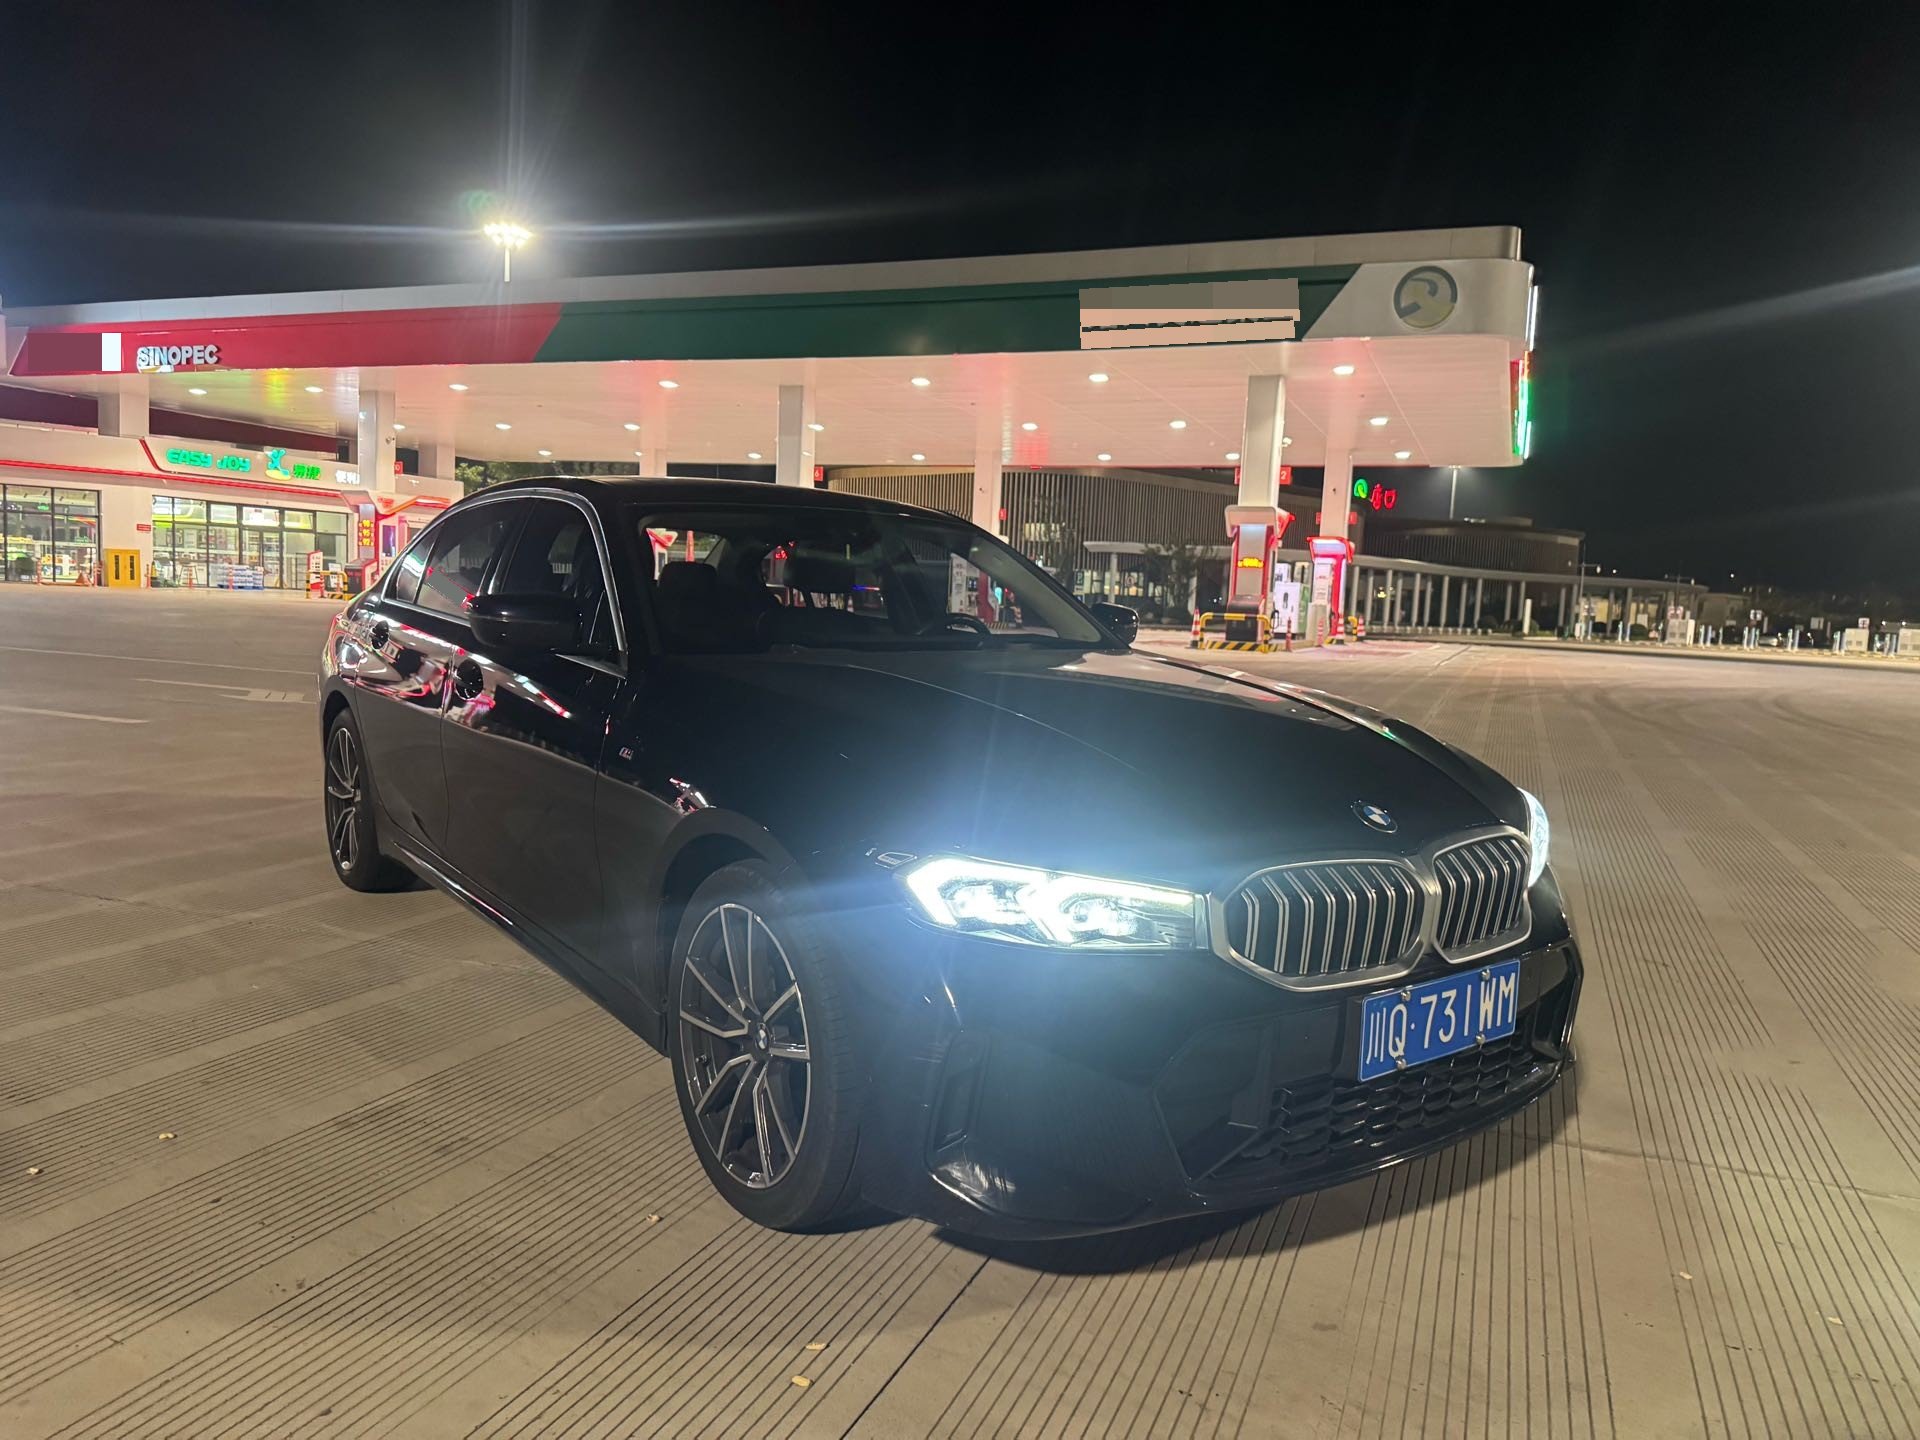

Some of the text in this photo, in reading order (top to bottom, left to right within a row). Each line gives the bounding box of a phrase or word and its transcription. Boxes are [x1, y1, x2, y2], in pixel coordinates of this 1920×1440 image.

[137, 344, 219, 367] SINOPEC
[167, 448, 251, 472] EASY JOY
